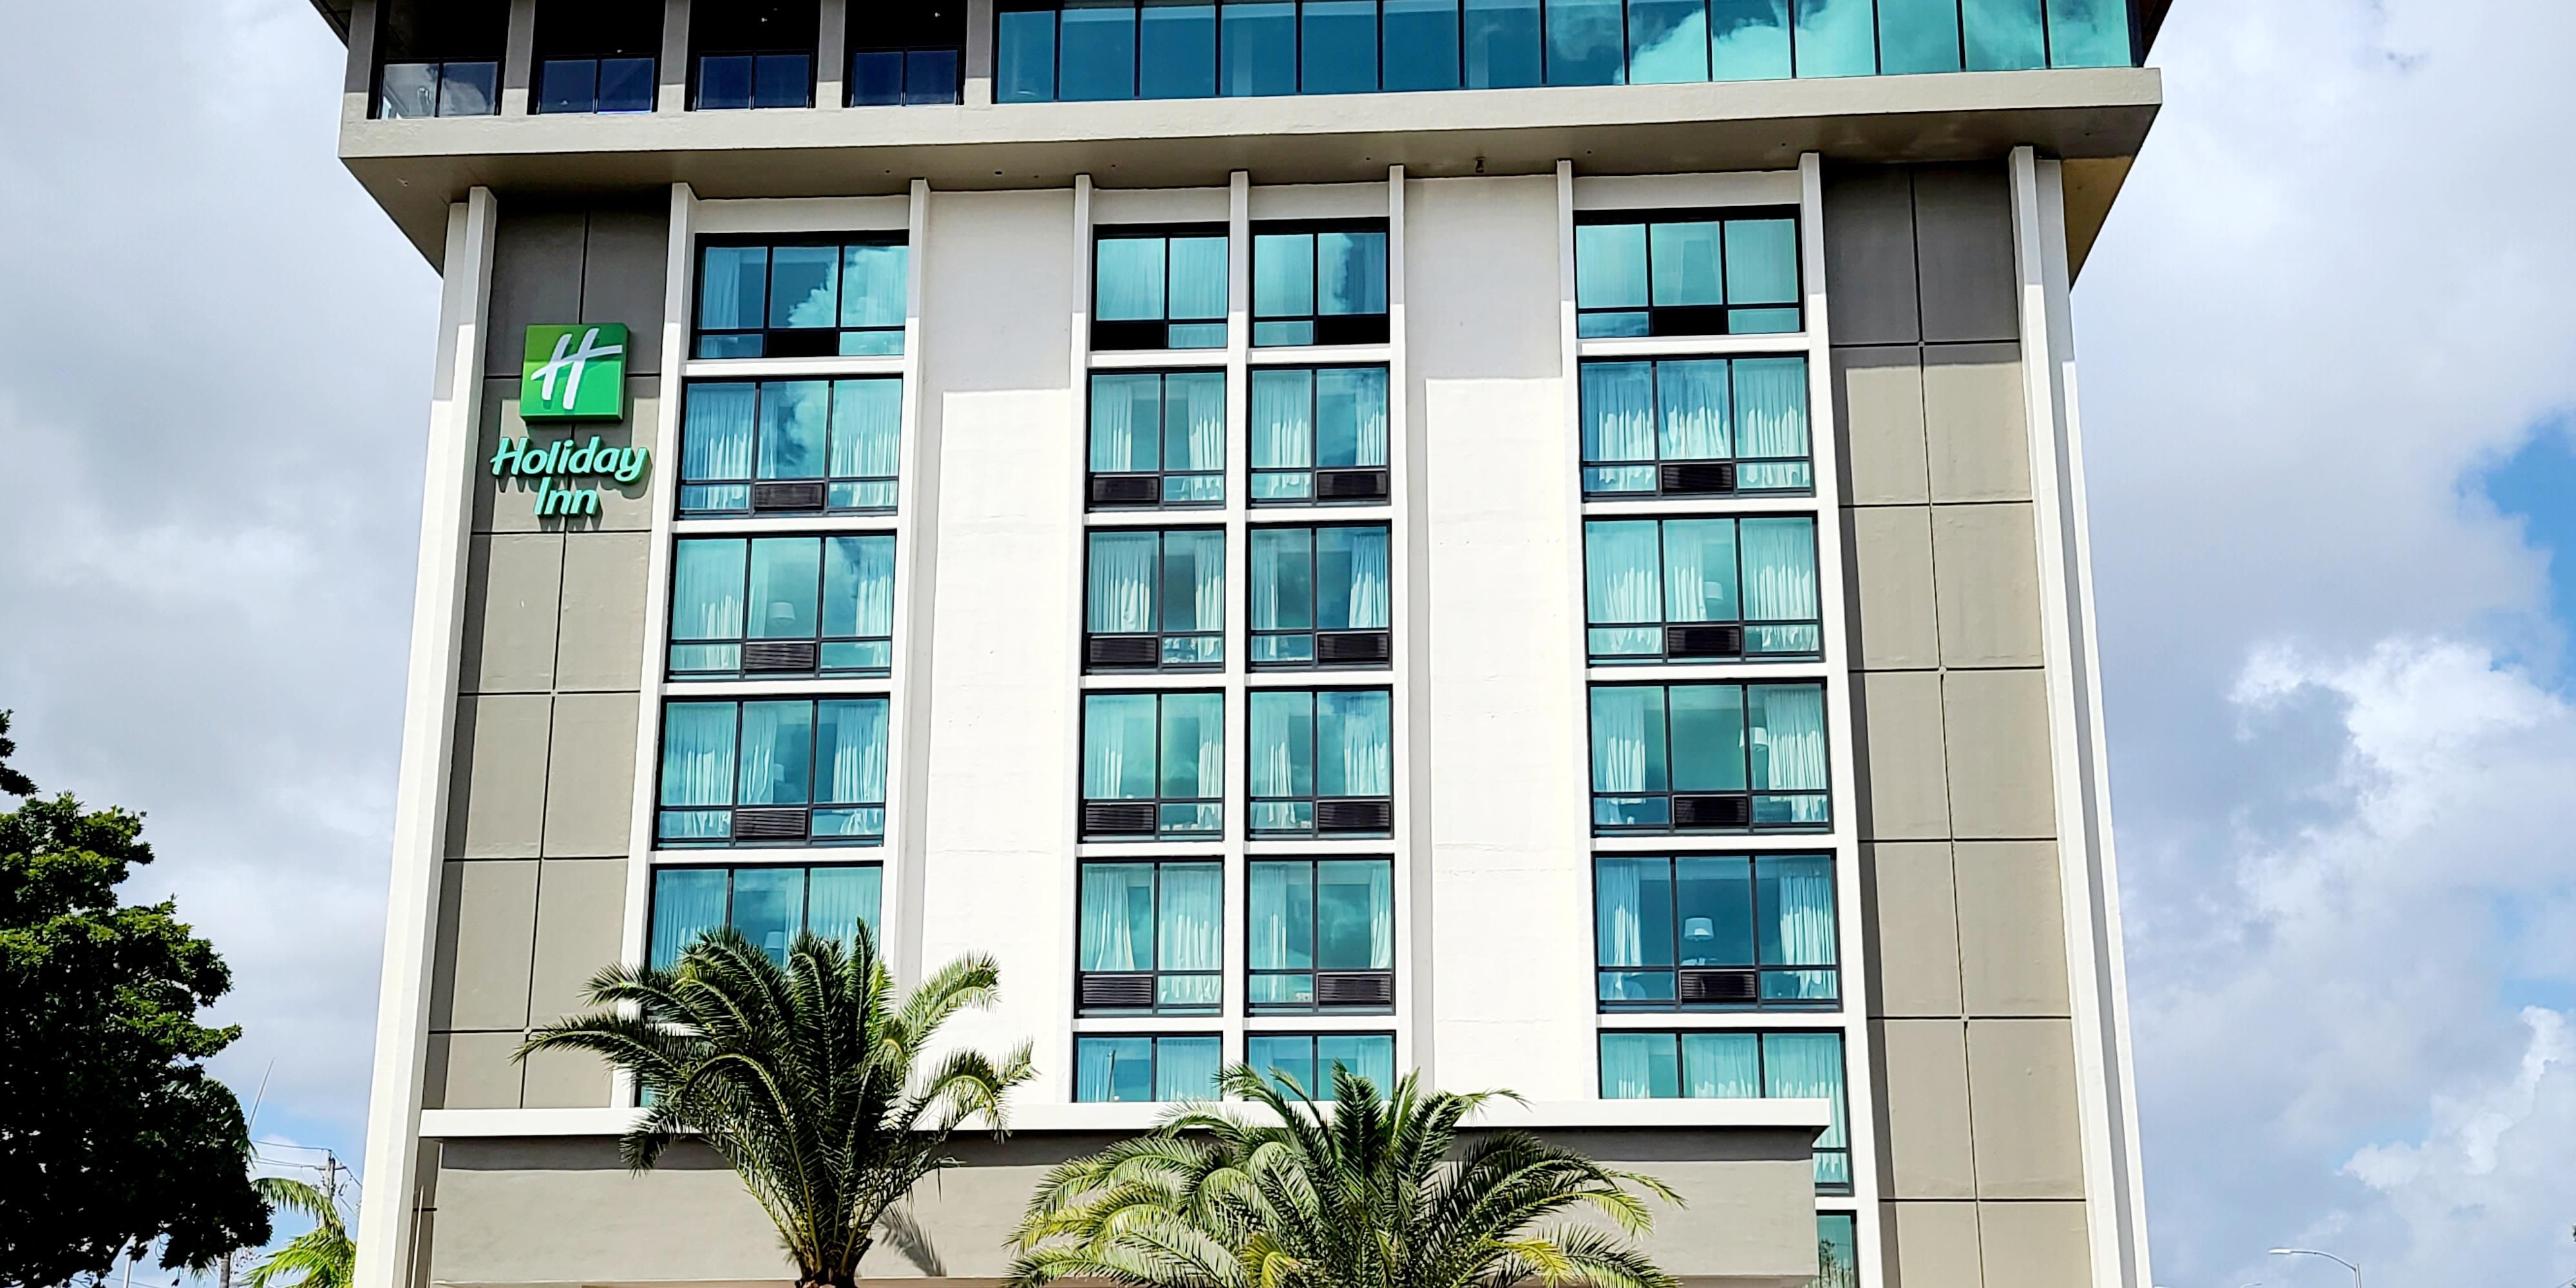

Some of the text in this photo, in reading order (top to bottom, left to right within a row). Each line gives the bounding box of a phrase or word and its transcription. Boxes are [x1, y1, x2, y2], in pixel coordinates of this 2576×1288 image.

[531, 328, 623, 410] H
[489, 436, 648, 482] Holiday
[534, 477, 599, 515] Inn
